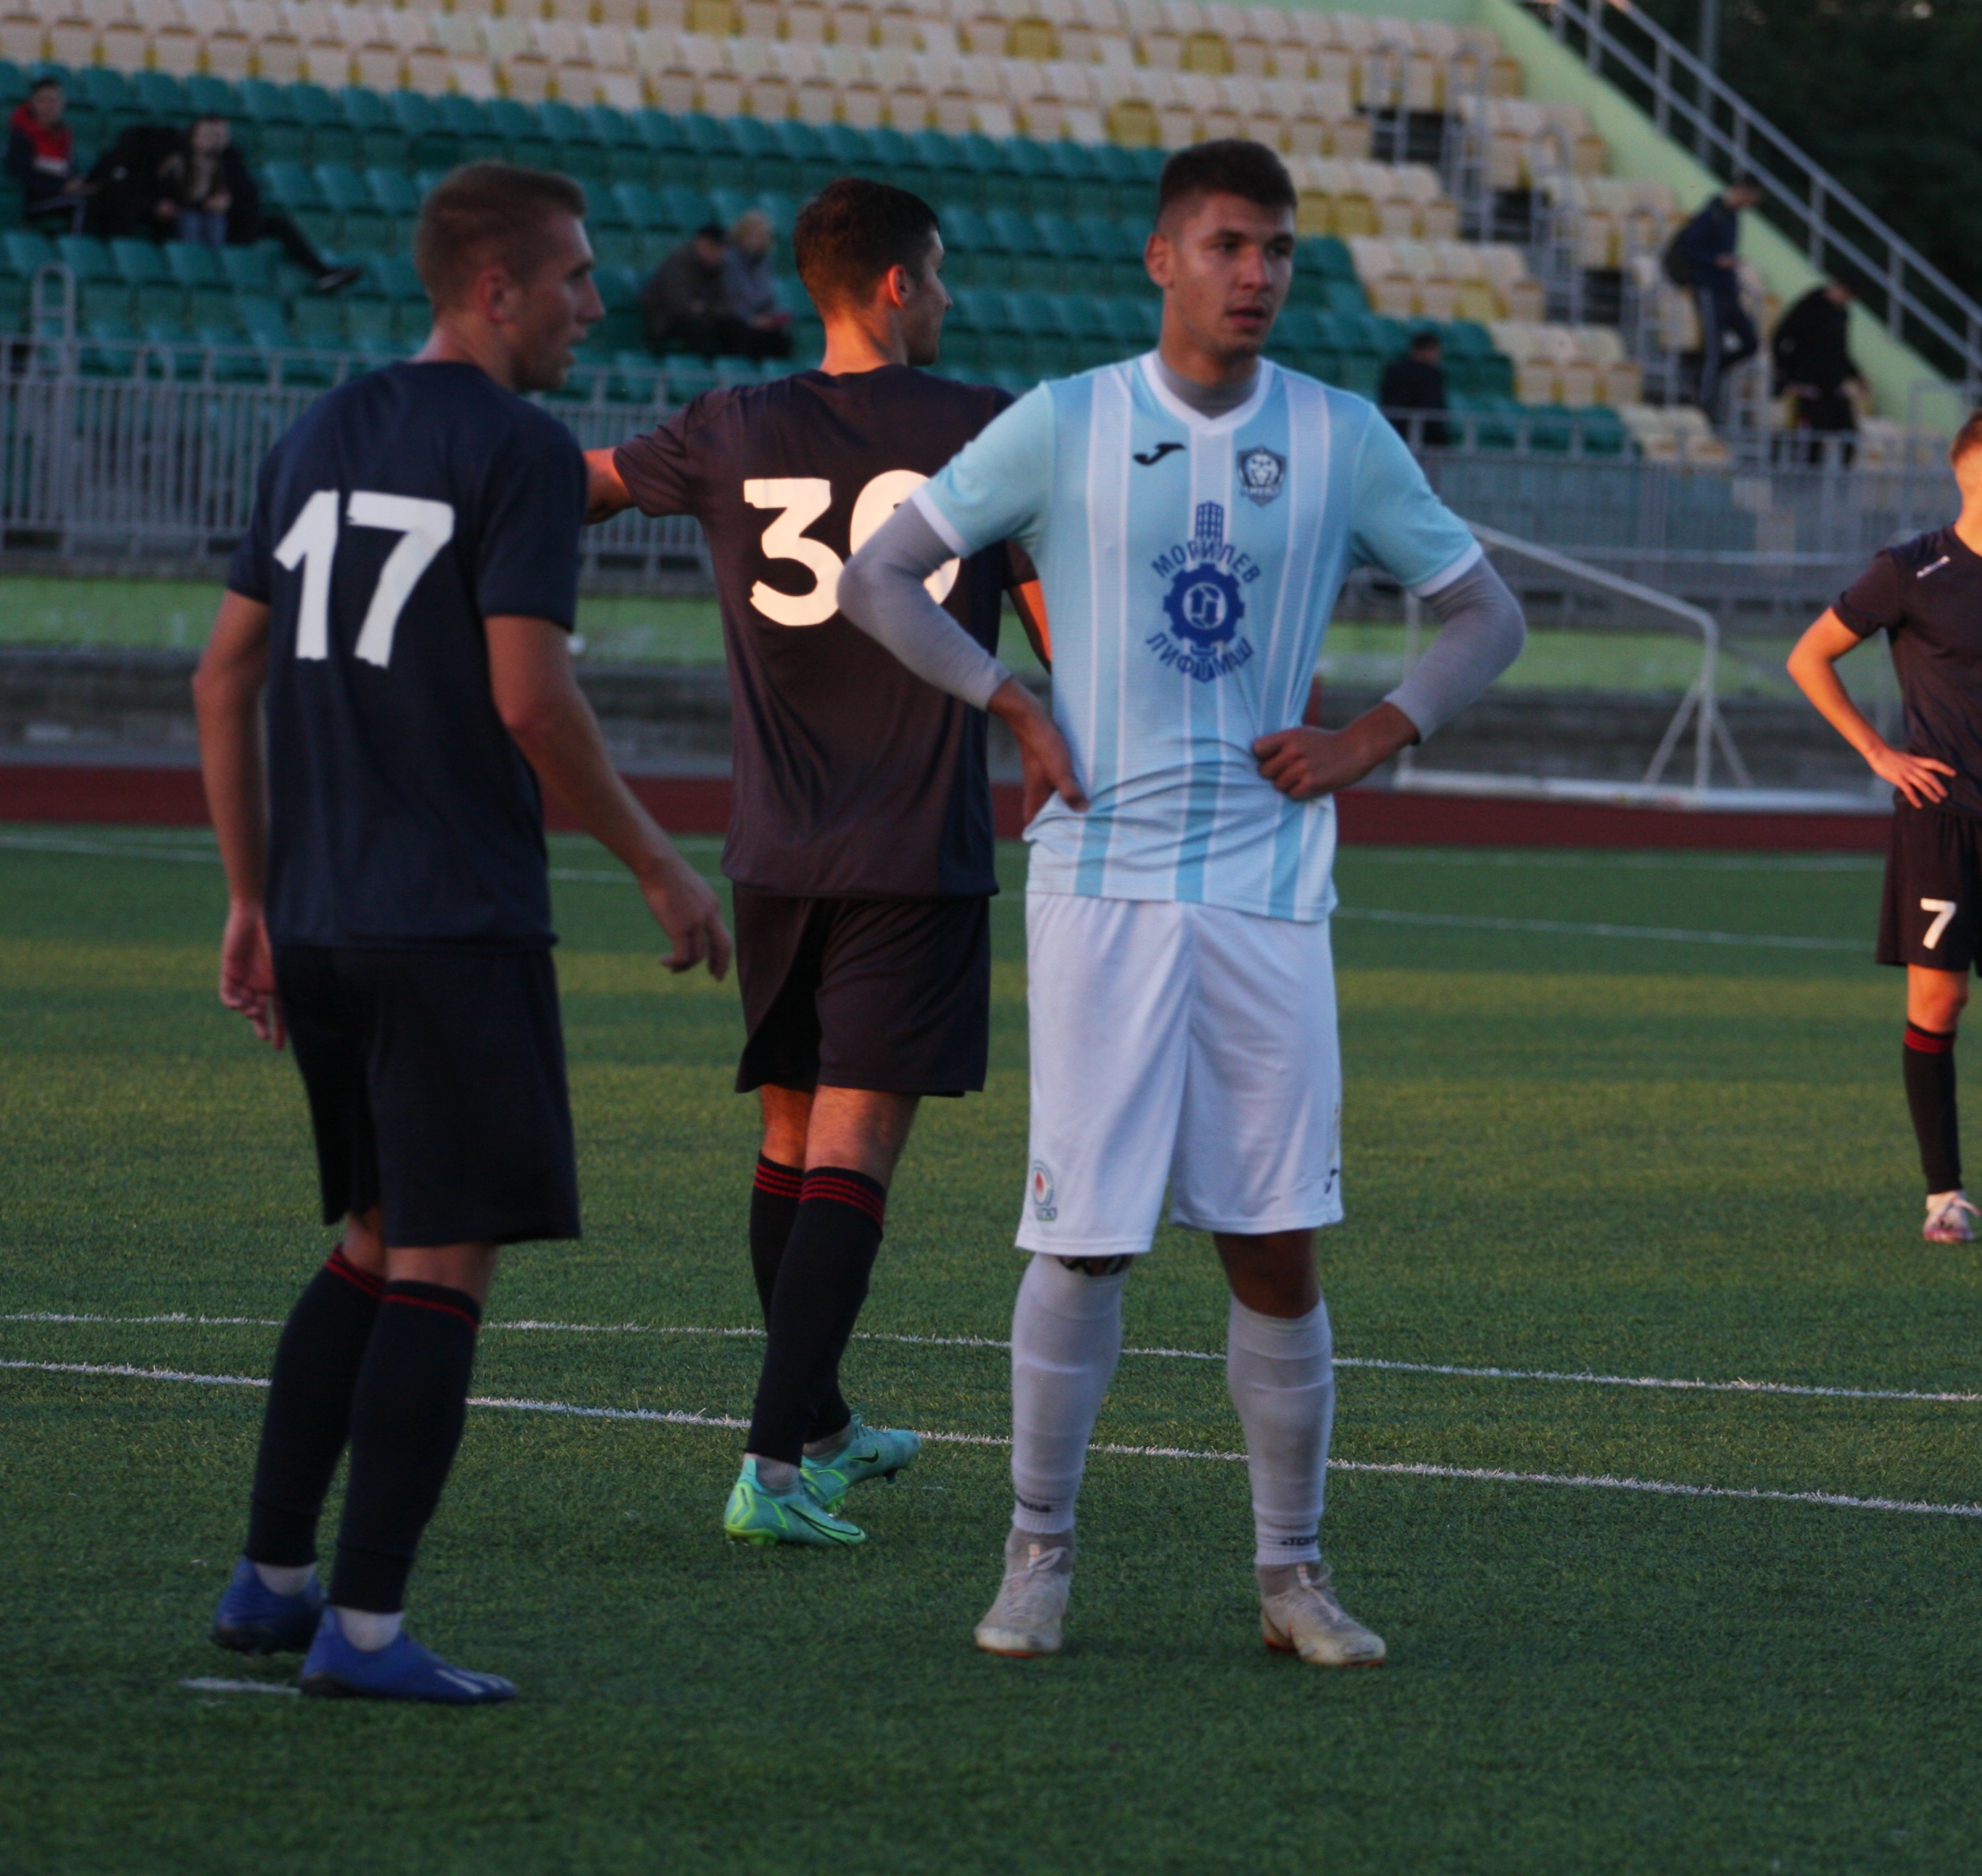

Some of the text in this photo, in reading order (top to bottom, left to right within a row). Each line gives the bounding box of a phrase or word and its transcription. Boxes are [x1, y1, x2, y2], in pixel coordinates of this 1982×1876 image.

[273, 489, 456, 668] 17
[1151, 539, 1261, 583] МОГИЛЕВ
[1920, 897, 1957, 950] 7
